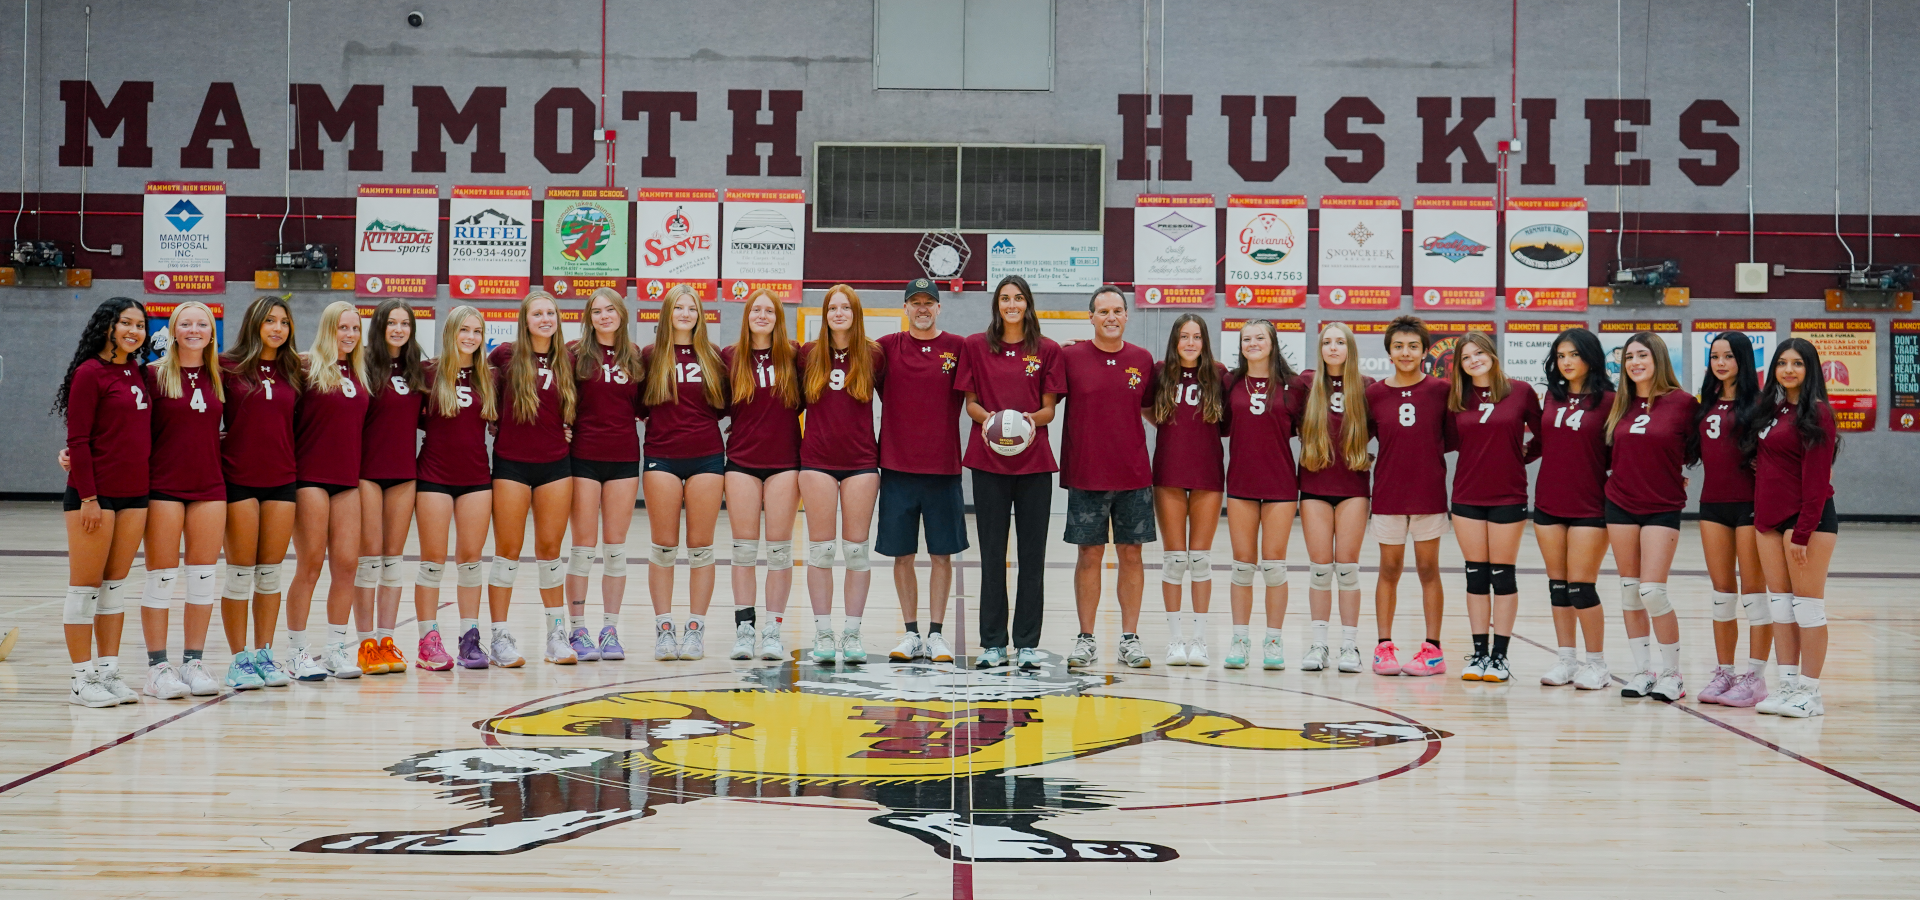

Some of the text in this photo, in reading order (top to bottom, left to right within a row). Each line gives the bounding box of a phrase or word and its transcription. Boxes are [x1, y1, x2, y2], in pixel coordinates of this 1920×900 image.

[58, 79, 803, 178] MAMMOTH
[1116, 93, 1740, 187] HUSKIES
[454, 226, 527, 239] RIFFEL
[1525, 226, 1551, 236] MAMMOTH
[360, 232, 434, 252] KITTREDGE
[397, 244, 431, 255] sports
[453, 248, 526, 257] 760-934-4907
[669, 261, 692, 273] MAMMOTH
[1230, 271, 1302, 280] 760.934.7563
[1895, 335, 1918, 345] DON'T
[1895, 345, 1919, 355] TRADE
[1895, 355, 1914, 364] YOUR
[538, 368, 553, 390] 7
[602, 364, 629, 384] 13
[675, 362, 702, 382] 12
[829, 369, 846, 390] 9
[1895, 374, 1916, 382] FOR A
[262, 380, 272, 400] 1
[391, 376, 410, 395] 6
[1175, 383, 1200, 406] 10
[1895, 383, 1919, 392] TREND
[131, 385, 148, 410] 2
[190, 388, 206, 413] 4
[456, 386, 472, 407] 5
[1250, 393, 1267, 415] 5
[1330, 392, 1345, 412] 9
[1399, 403, 1416, 427] 8
[1478, 403, 1495, 423] 7
[1554, 407, 1584, 431] 14
[1629, 414, 1650, 434] 2
[1706, 414, 1721, 439] 3
